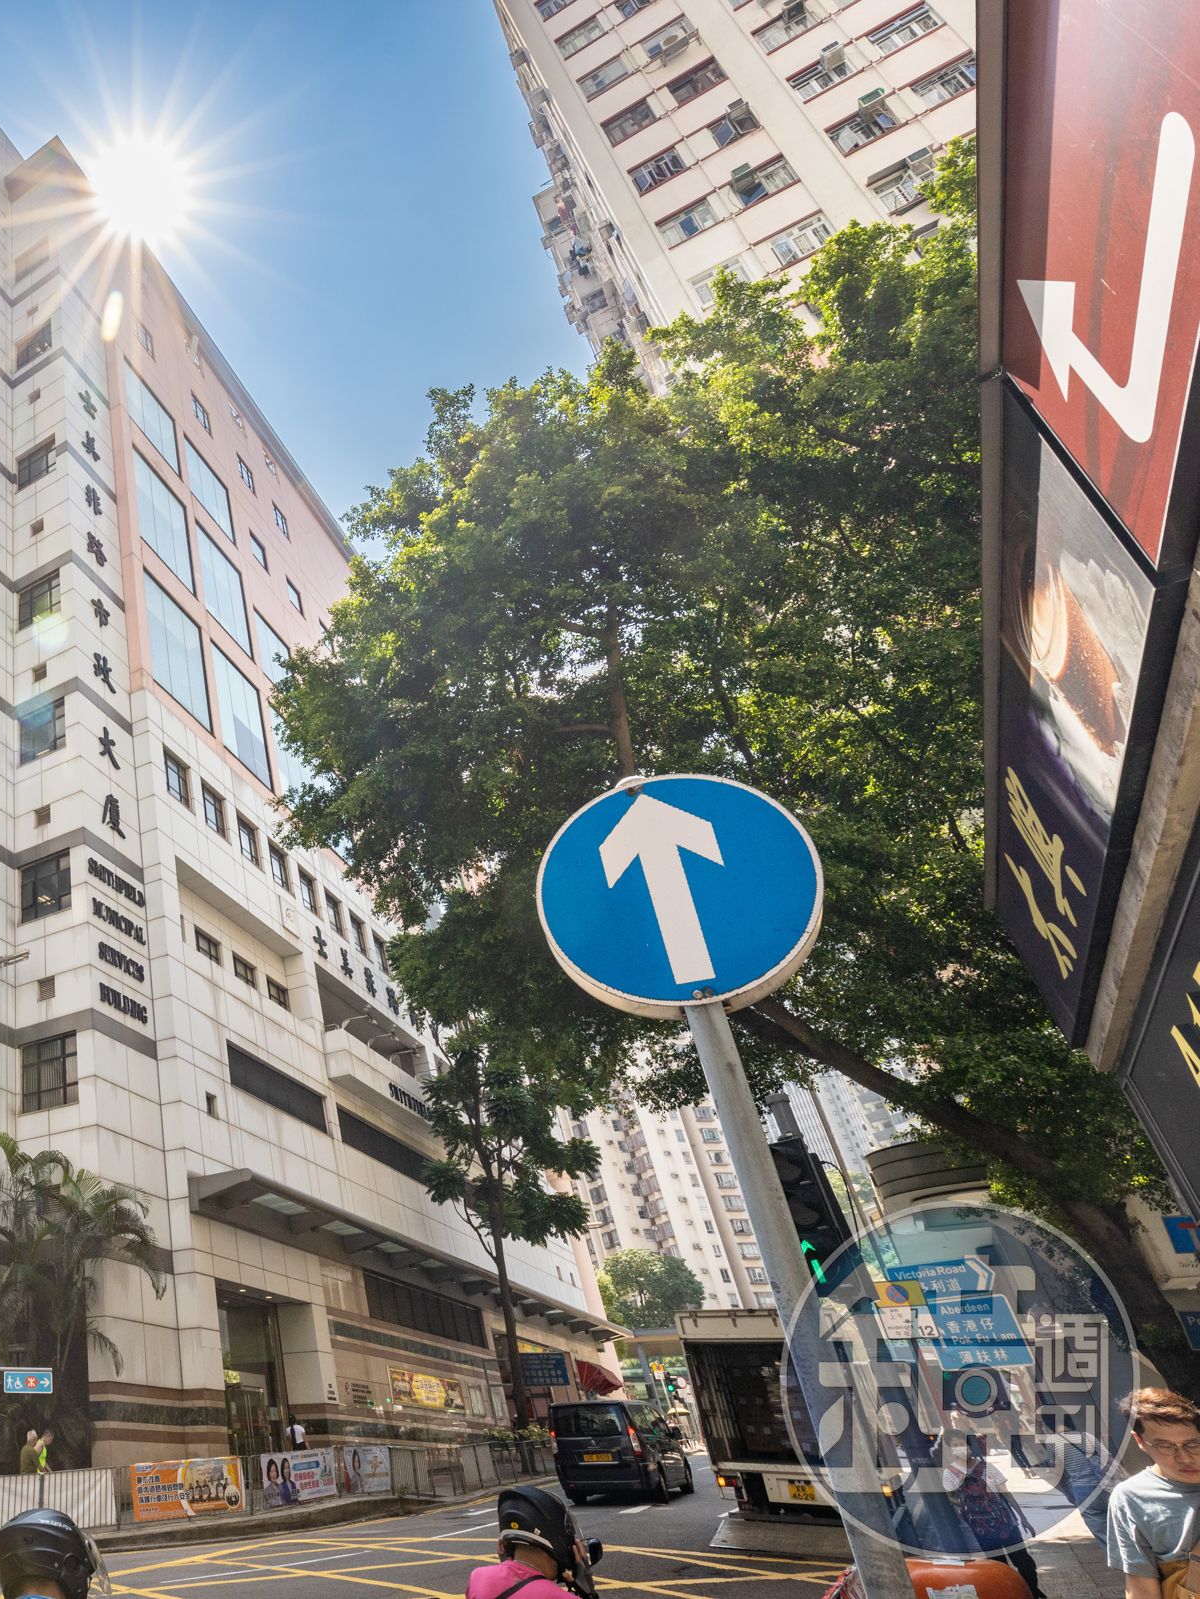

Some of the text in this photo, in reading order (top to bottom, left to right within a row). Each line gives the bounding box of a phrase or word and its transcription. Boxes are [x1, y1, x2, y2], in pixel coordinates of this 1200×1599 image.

[88, 857, 146, 908] SMITHFIELD
[92, 897, 147, 946] MUNICIPAL
[98, 941, 145, 984] SERVICES
[99, 982, 149, 1025] BUILDING
[894, 1263, 967, 1281] Victoria Road
[940, 1302, 990, 1316] Aberdeen
[918, 1325, 936, 1337] 12
[946, 1317, 995, 1334] 香港仔
[952, 1331, 1017, 1346] Pok Fu Lam
[958, 1348, 1009, 1364] 薄扶林
